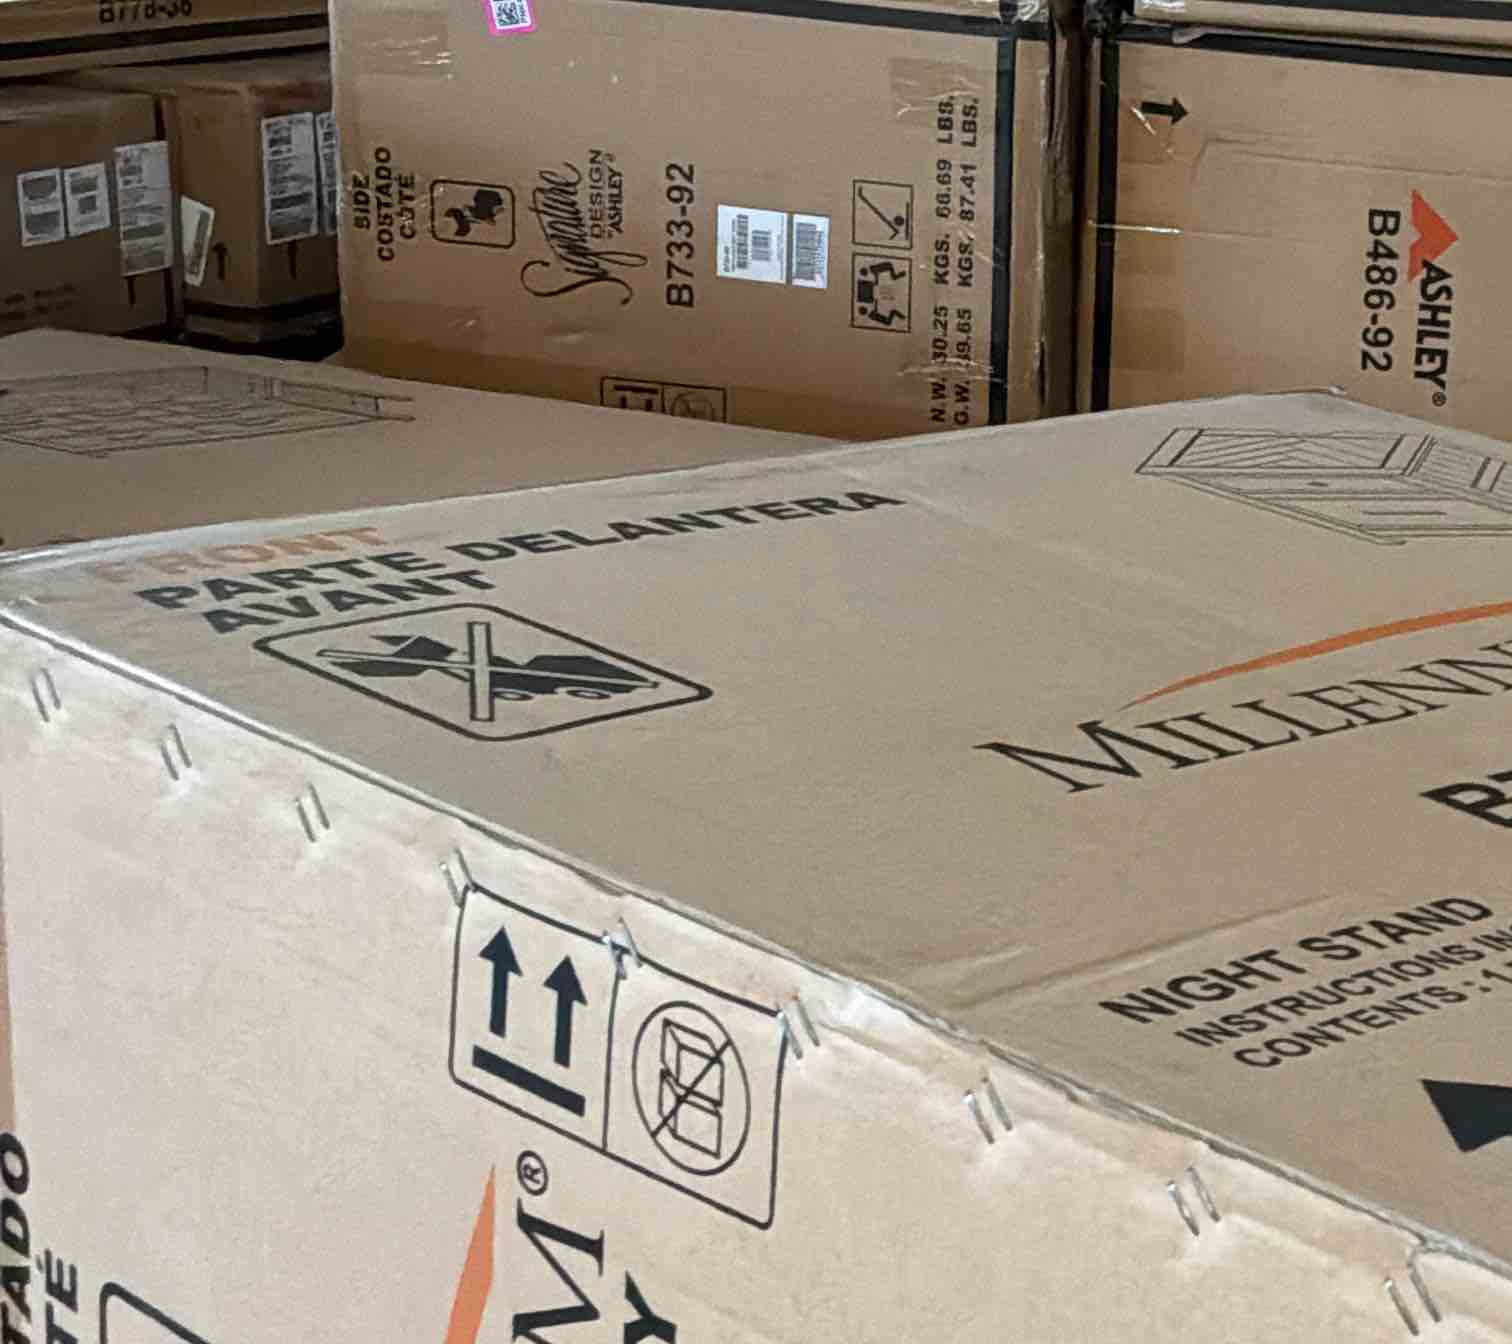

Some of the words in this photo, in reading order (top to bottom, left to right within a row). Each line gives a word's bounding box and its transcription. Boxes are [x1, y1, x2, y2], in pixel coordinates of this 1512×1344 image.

[937, 95, 955, 144] LBS.
[960, 98, 979, 148] LBS.
[375, 146, 394, 262] COSTADO
[588, 149, 604, 240] DESIGN
[936, 159, 952, 219] 66.69
[960, 163, 977, 222] 87.41
[666, 163, 695, 308] B733-92
[934, 233, 951, 286] KGS.
[958, 235, 975, 287] KGS.
[1361, 208, 1402, 372] B486-92
[932, 305, 949, 365] 30.25
[953, 379, 971, 425] G.W.
[84, 526, 388, 584] FRONT
[135, 551, 448, 609] PARTE
[444, 489, 907, 565] DELANTERA
[202, 569, 496, 634] AVANT
[1100, 948, 1304, 1025] NIGHT
[1298, 896, 1493, 980] STAND
[1173, 943, 1486, 1049] INSTRUCTIONS
[1233, 985, 1468, 1069] CONTENTS
